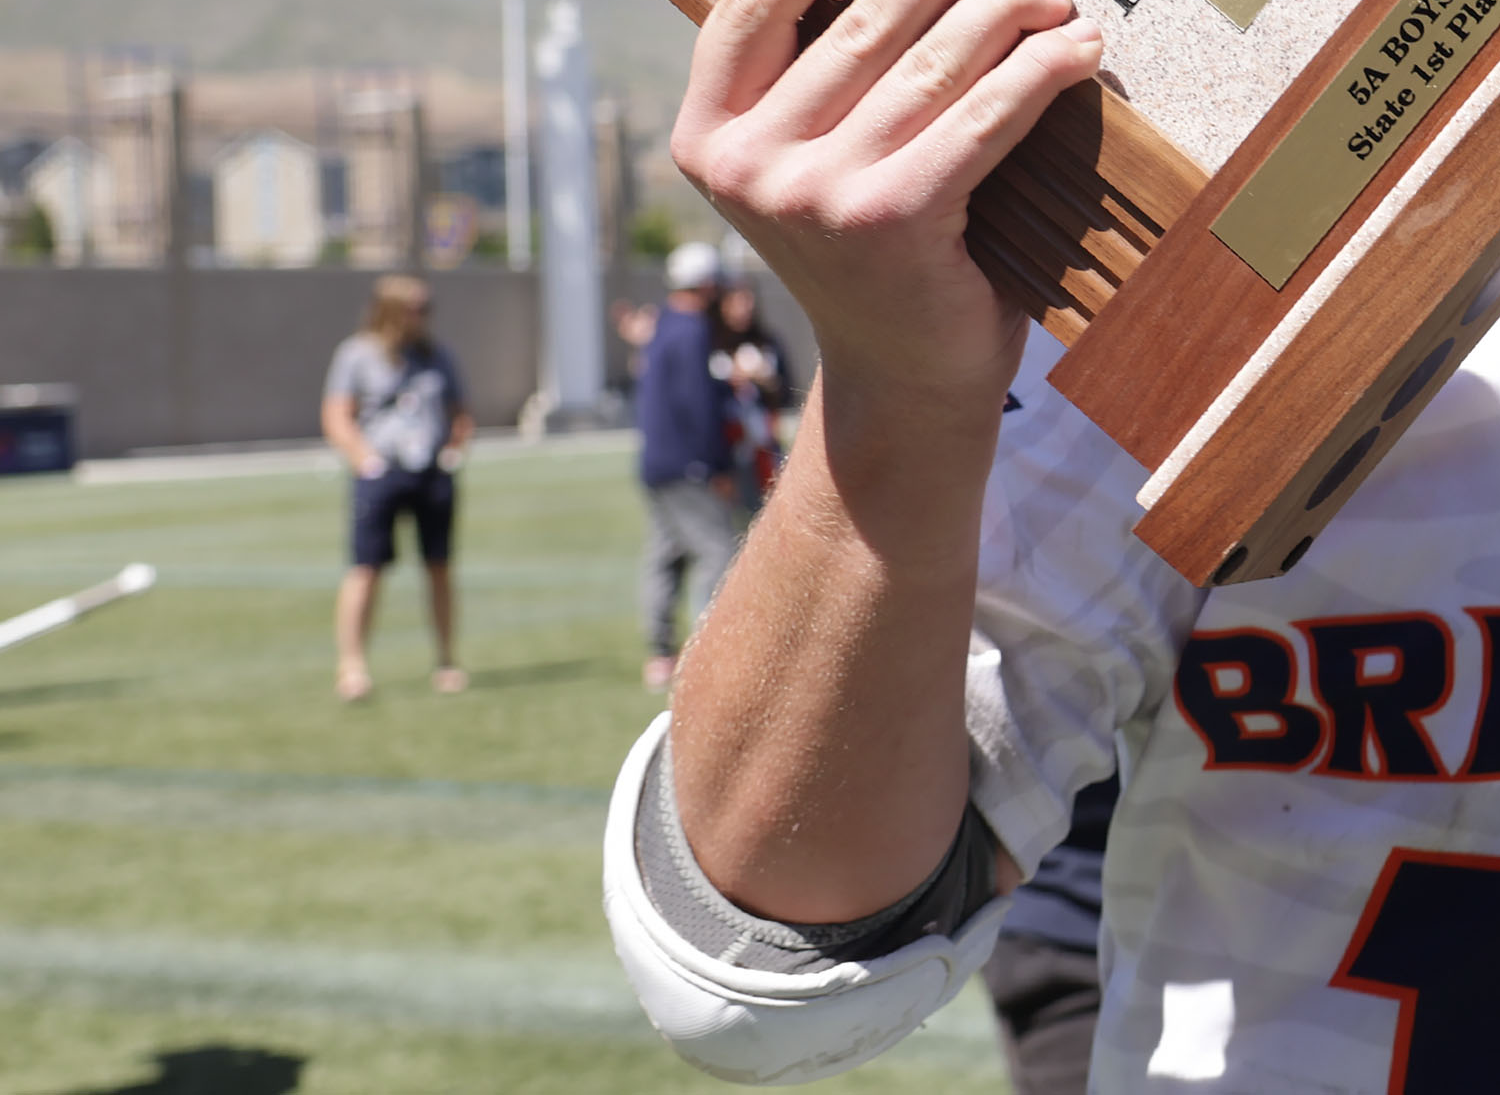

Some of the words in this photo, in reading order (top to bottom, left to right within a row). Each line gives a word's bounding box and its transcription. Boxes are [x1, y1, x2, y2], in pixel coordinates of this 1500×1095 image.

[1347, 64, 1390, 107] 5A
[1347, 86, 1417, 161] State
[1410, 40, 1455, 87] 1st
